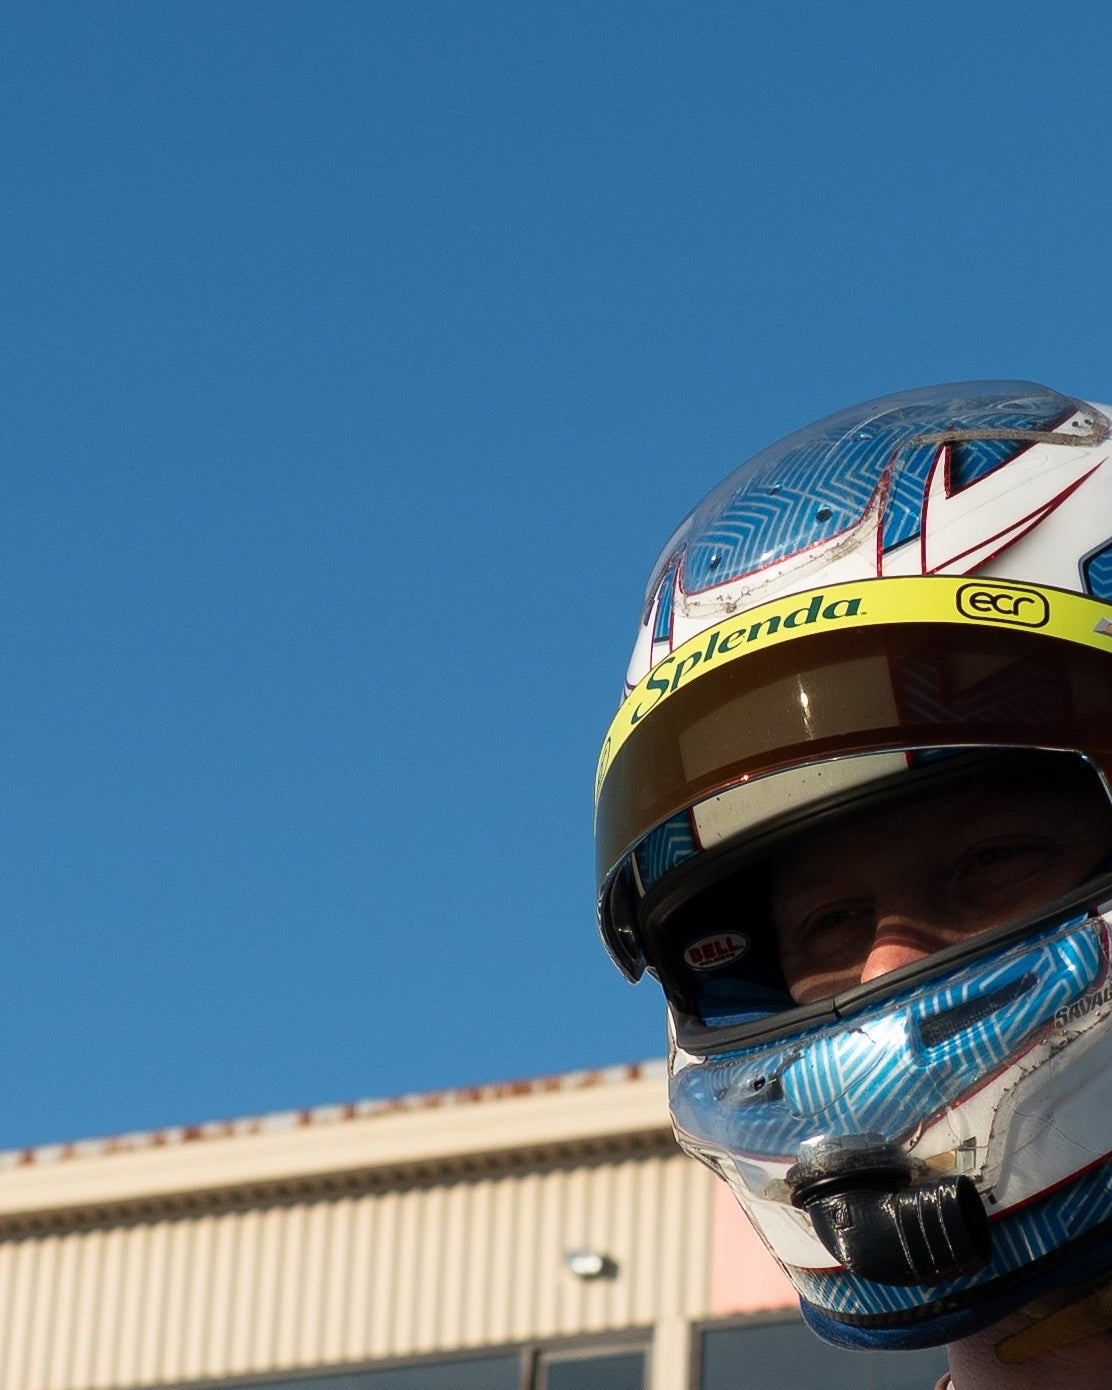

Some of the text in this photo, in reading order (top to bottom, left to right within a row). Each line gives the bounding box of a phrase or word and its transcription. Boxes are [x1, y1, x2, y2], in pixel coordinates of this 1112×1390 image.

[969, 591, 1036, 617] ecr
[631, 595, 862, 725] Splenda
[688, 934, 745, 965] BELL
